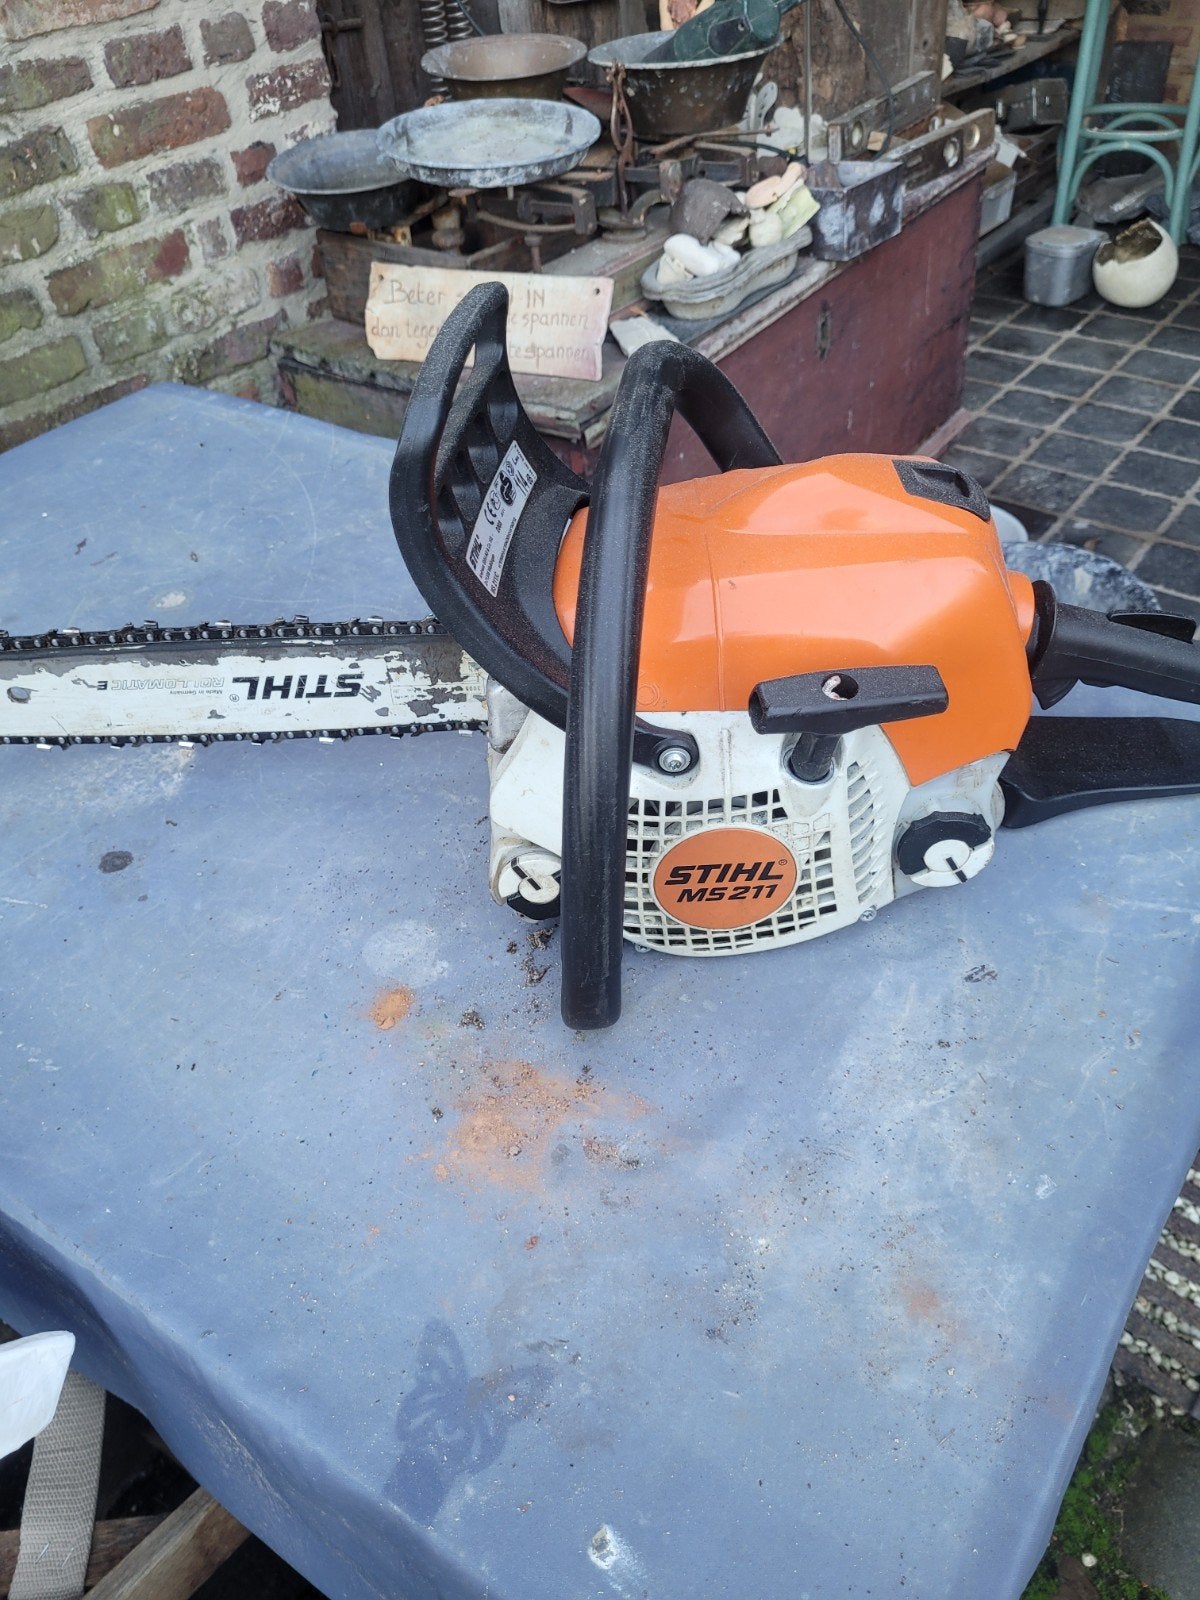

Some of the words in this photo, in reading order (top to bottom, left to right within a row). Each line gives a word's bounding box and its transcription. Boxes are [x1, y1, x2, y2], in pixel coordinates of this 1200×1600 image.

[383, 279, 445, 305] Beter
[526, 288, 546, 309] IN
[97, 680, 108, 691] E
[232, 673, 364, 700] STIHL
[664, 861, 784, 886] STIHL
